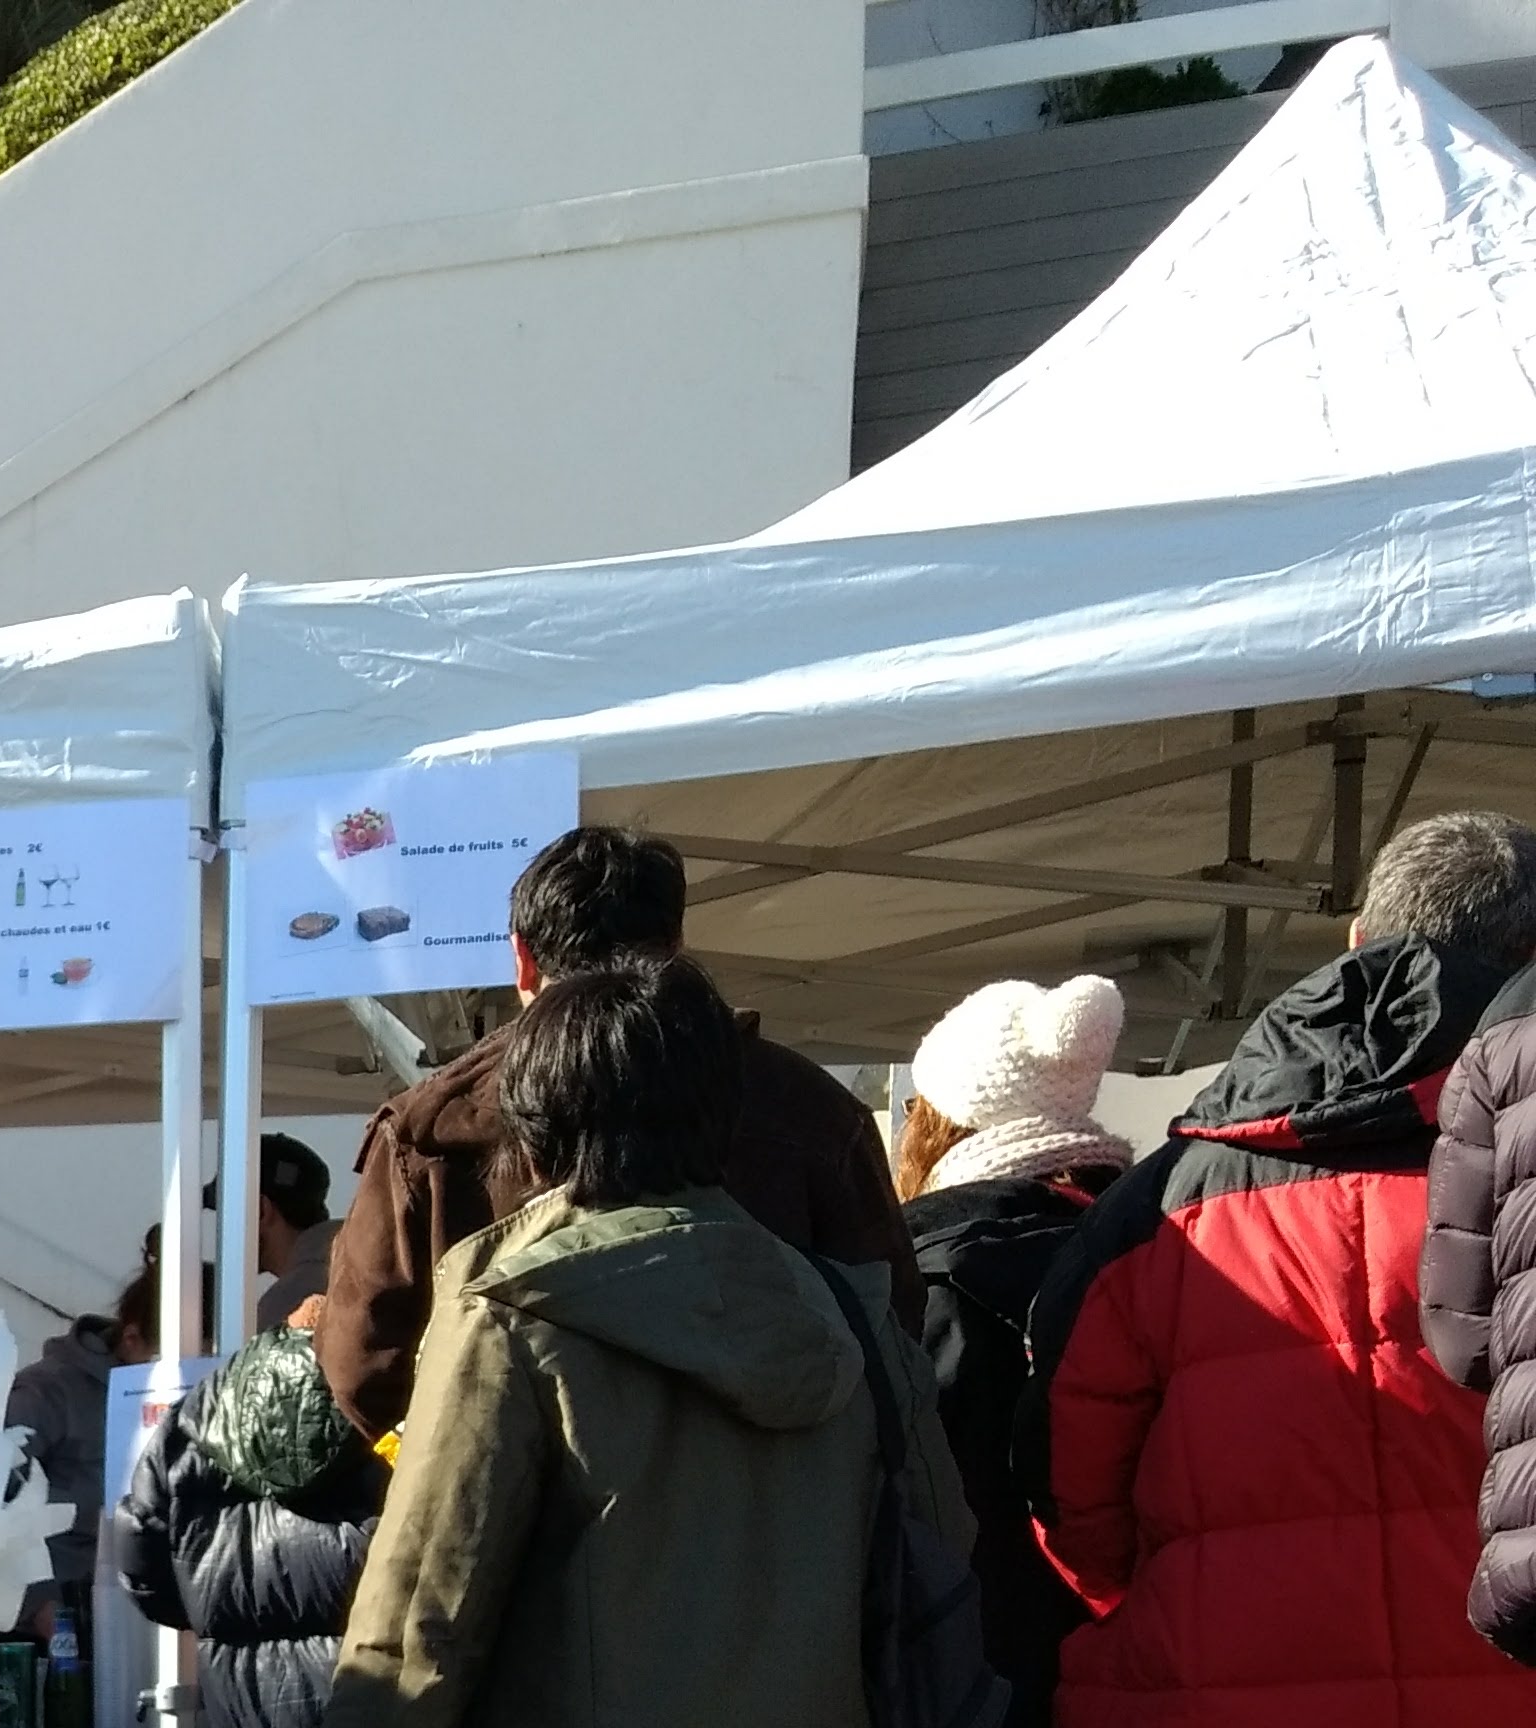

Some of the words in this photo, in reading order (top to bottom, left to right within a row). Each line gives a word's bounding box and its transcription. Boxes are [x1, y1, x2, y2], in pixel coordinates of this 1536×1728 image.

[27, 842, 44, 854] 2€
[400, 845, 444, 856] Salade
[449, 843, 465, 854] de
[469, 840, 504, 852] fruits
[511, 837, 529, 848] 5€
[0, 926, 51, 938] chaudes
[54, 924, 67, 934] et
[70, 923, 93, 933] eau
[95, 920, 112, 931] 1€
